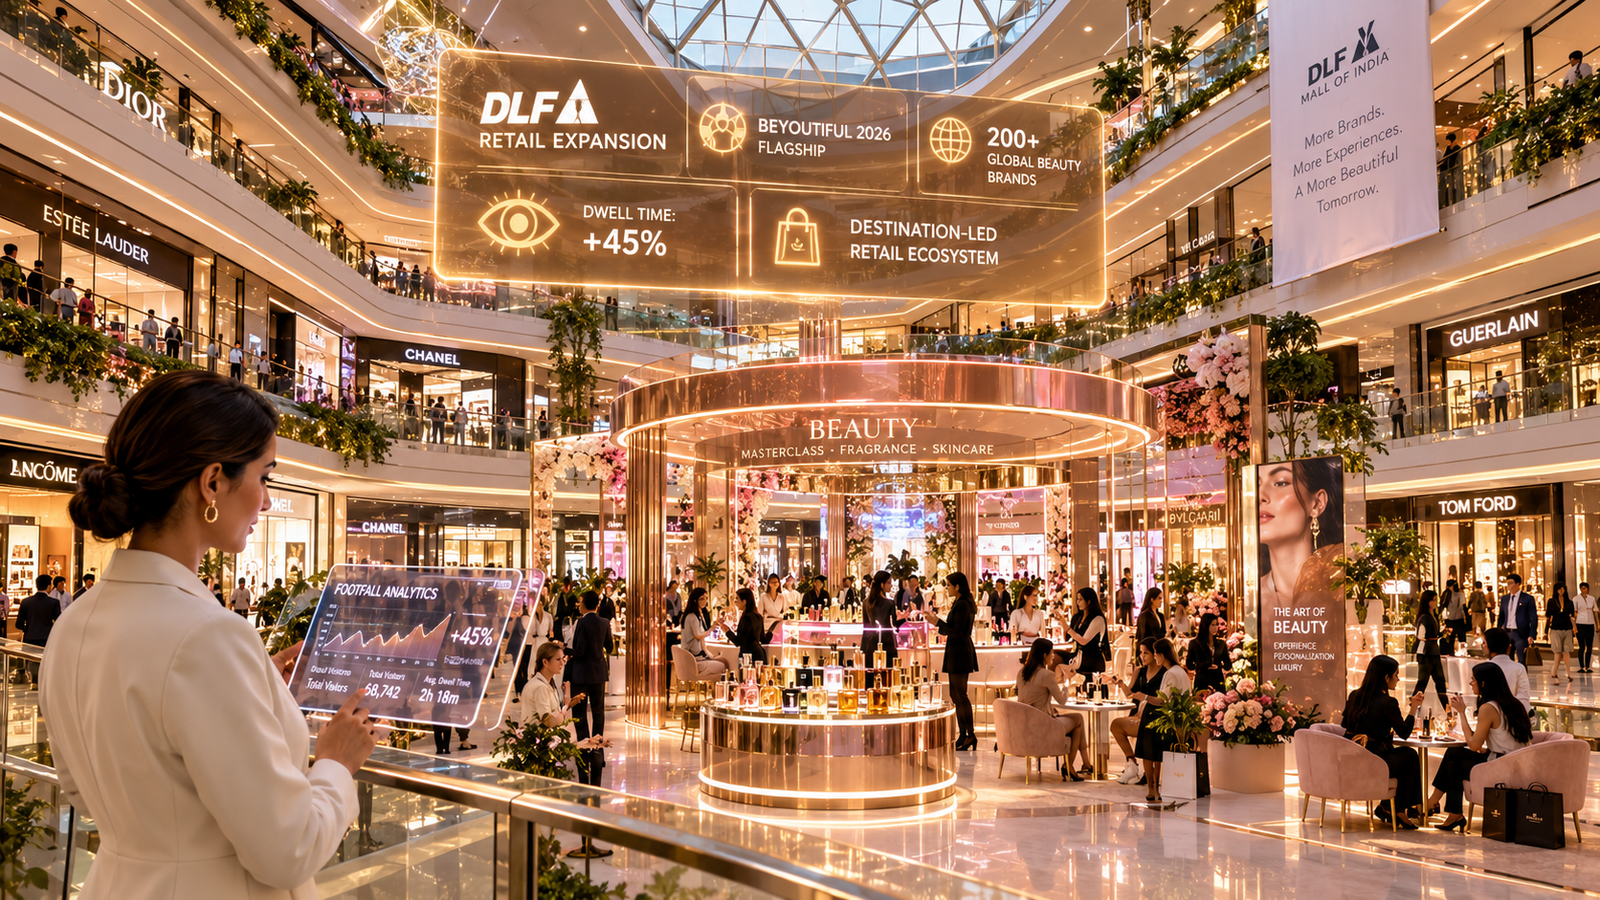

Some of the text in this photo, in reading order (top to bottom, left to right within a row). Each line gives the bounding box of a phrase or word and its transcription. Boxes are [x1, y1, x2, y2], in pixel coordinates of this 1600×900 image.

[1308, 46, 1347, 86] DLF
[1300, 51, 1389, 104] MALL OF INDIA
[100, 61, 167, 133] DIOR
[480, 91, 559, 124] DLF
[758, 118, 892, 142] BEYOUTIFUL 2026
[987, 126, 1040, 149] 200+
[1304, 105, 1385, 150] More Brands.
[480, 132, 666, 150] RETAIL EXPANSION
[758, 140, 826, 157] FLAGSHIP
[1293, 125, 1403, 177] More Experiences.
[987, 152, 1082, 172] GLOBAL BEAUTY
[1295, 145, 1399, 200] A More Beautiful
[988, 171, 1037, 186] BRANDS
[1317, 183, 1379, 214] Tomorrow.
[583, 205, 676, 222] DWELL TIME:
[850, 218, 998, 242] DESTINATION-LED
[95, 227, 150, 265] LAUDER
[583, 228, 667, 257] +45%
[850, 244, 999, 266] RETAIL ECOSYSTEM
[1450, 310, 1539, 347] GUERLAIN
[405, 348, 460, 366] CHANEL
[810, 418, 918, 440] BEAUTY
[741, 444, 994, 460] MASTERCLASS FRAGRANCE SKINCARE
[1438, 496, 1517, 516] TOM FORD
[362, 521, 406, 534] CHANEL
[334, 582, 439, 600] FOOTFALL ANALYTICS
[1273, 607, 1326, 616] THE ART OF
[450, 626, 494, 646] +45%
[1274, 620, 1328, 634] BEAUTY
[418, 688, 460, 705] 2h 18m
